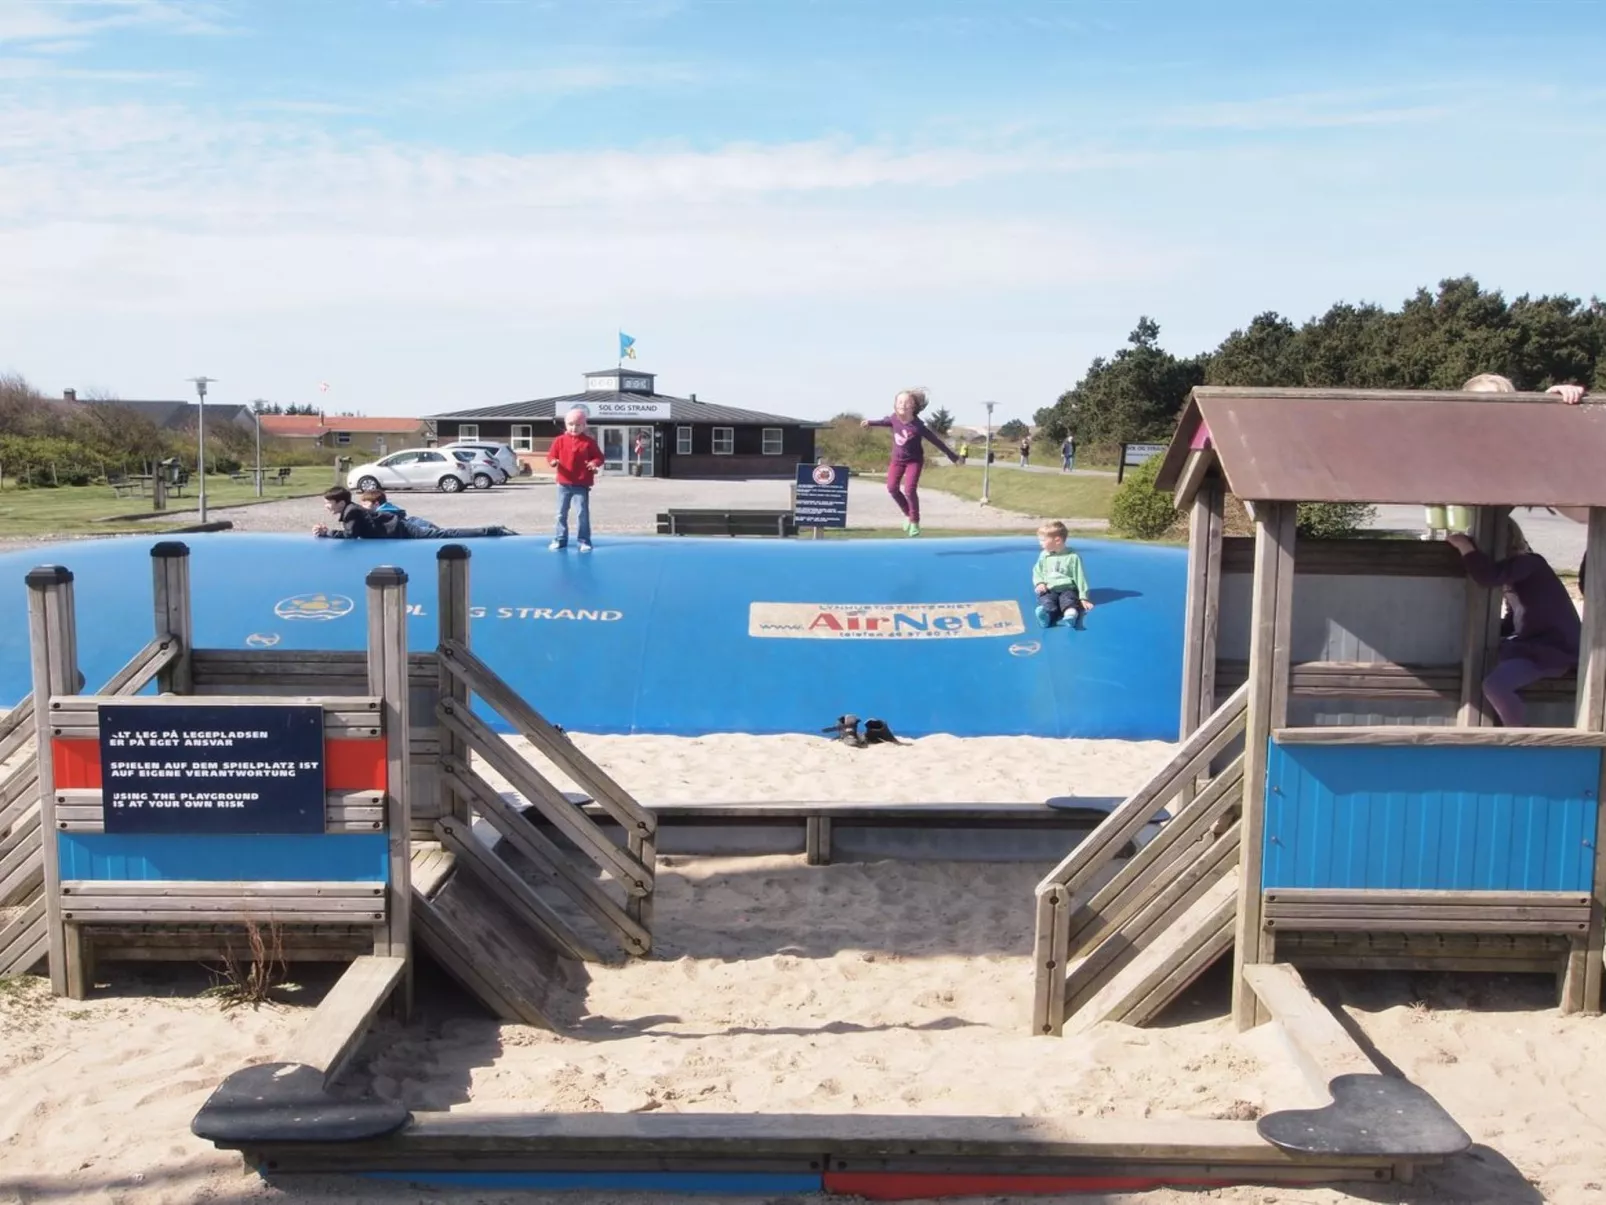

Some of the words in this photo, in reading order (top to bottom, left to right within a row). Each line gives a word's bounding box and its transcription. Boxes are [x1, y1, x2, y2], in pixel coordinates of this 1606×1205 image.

[627, 404, 658, 412] STRAND
[496, 607, 624, 621] STRAND
[162, 729, 179, 738] PÅ
[129, 737, 146, 746] PÅ
